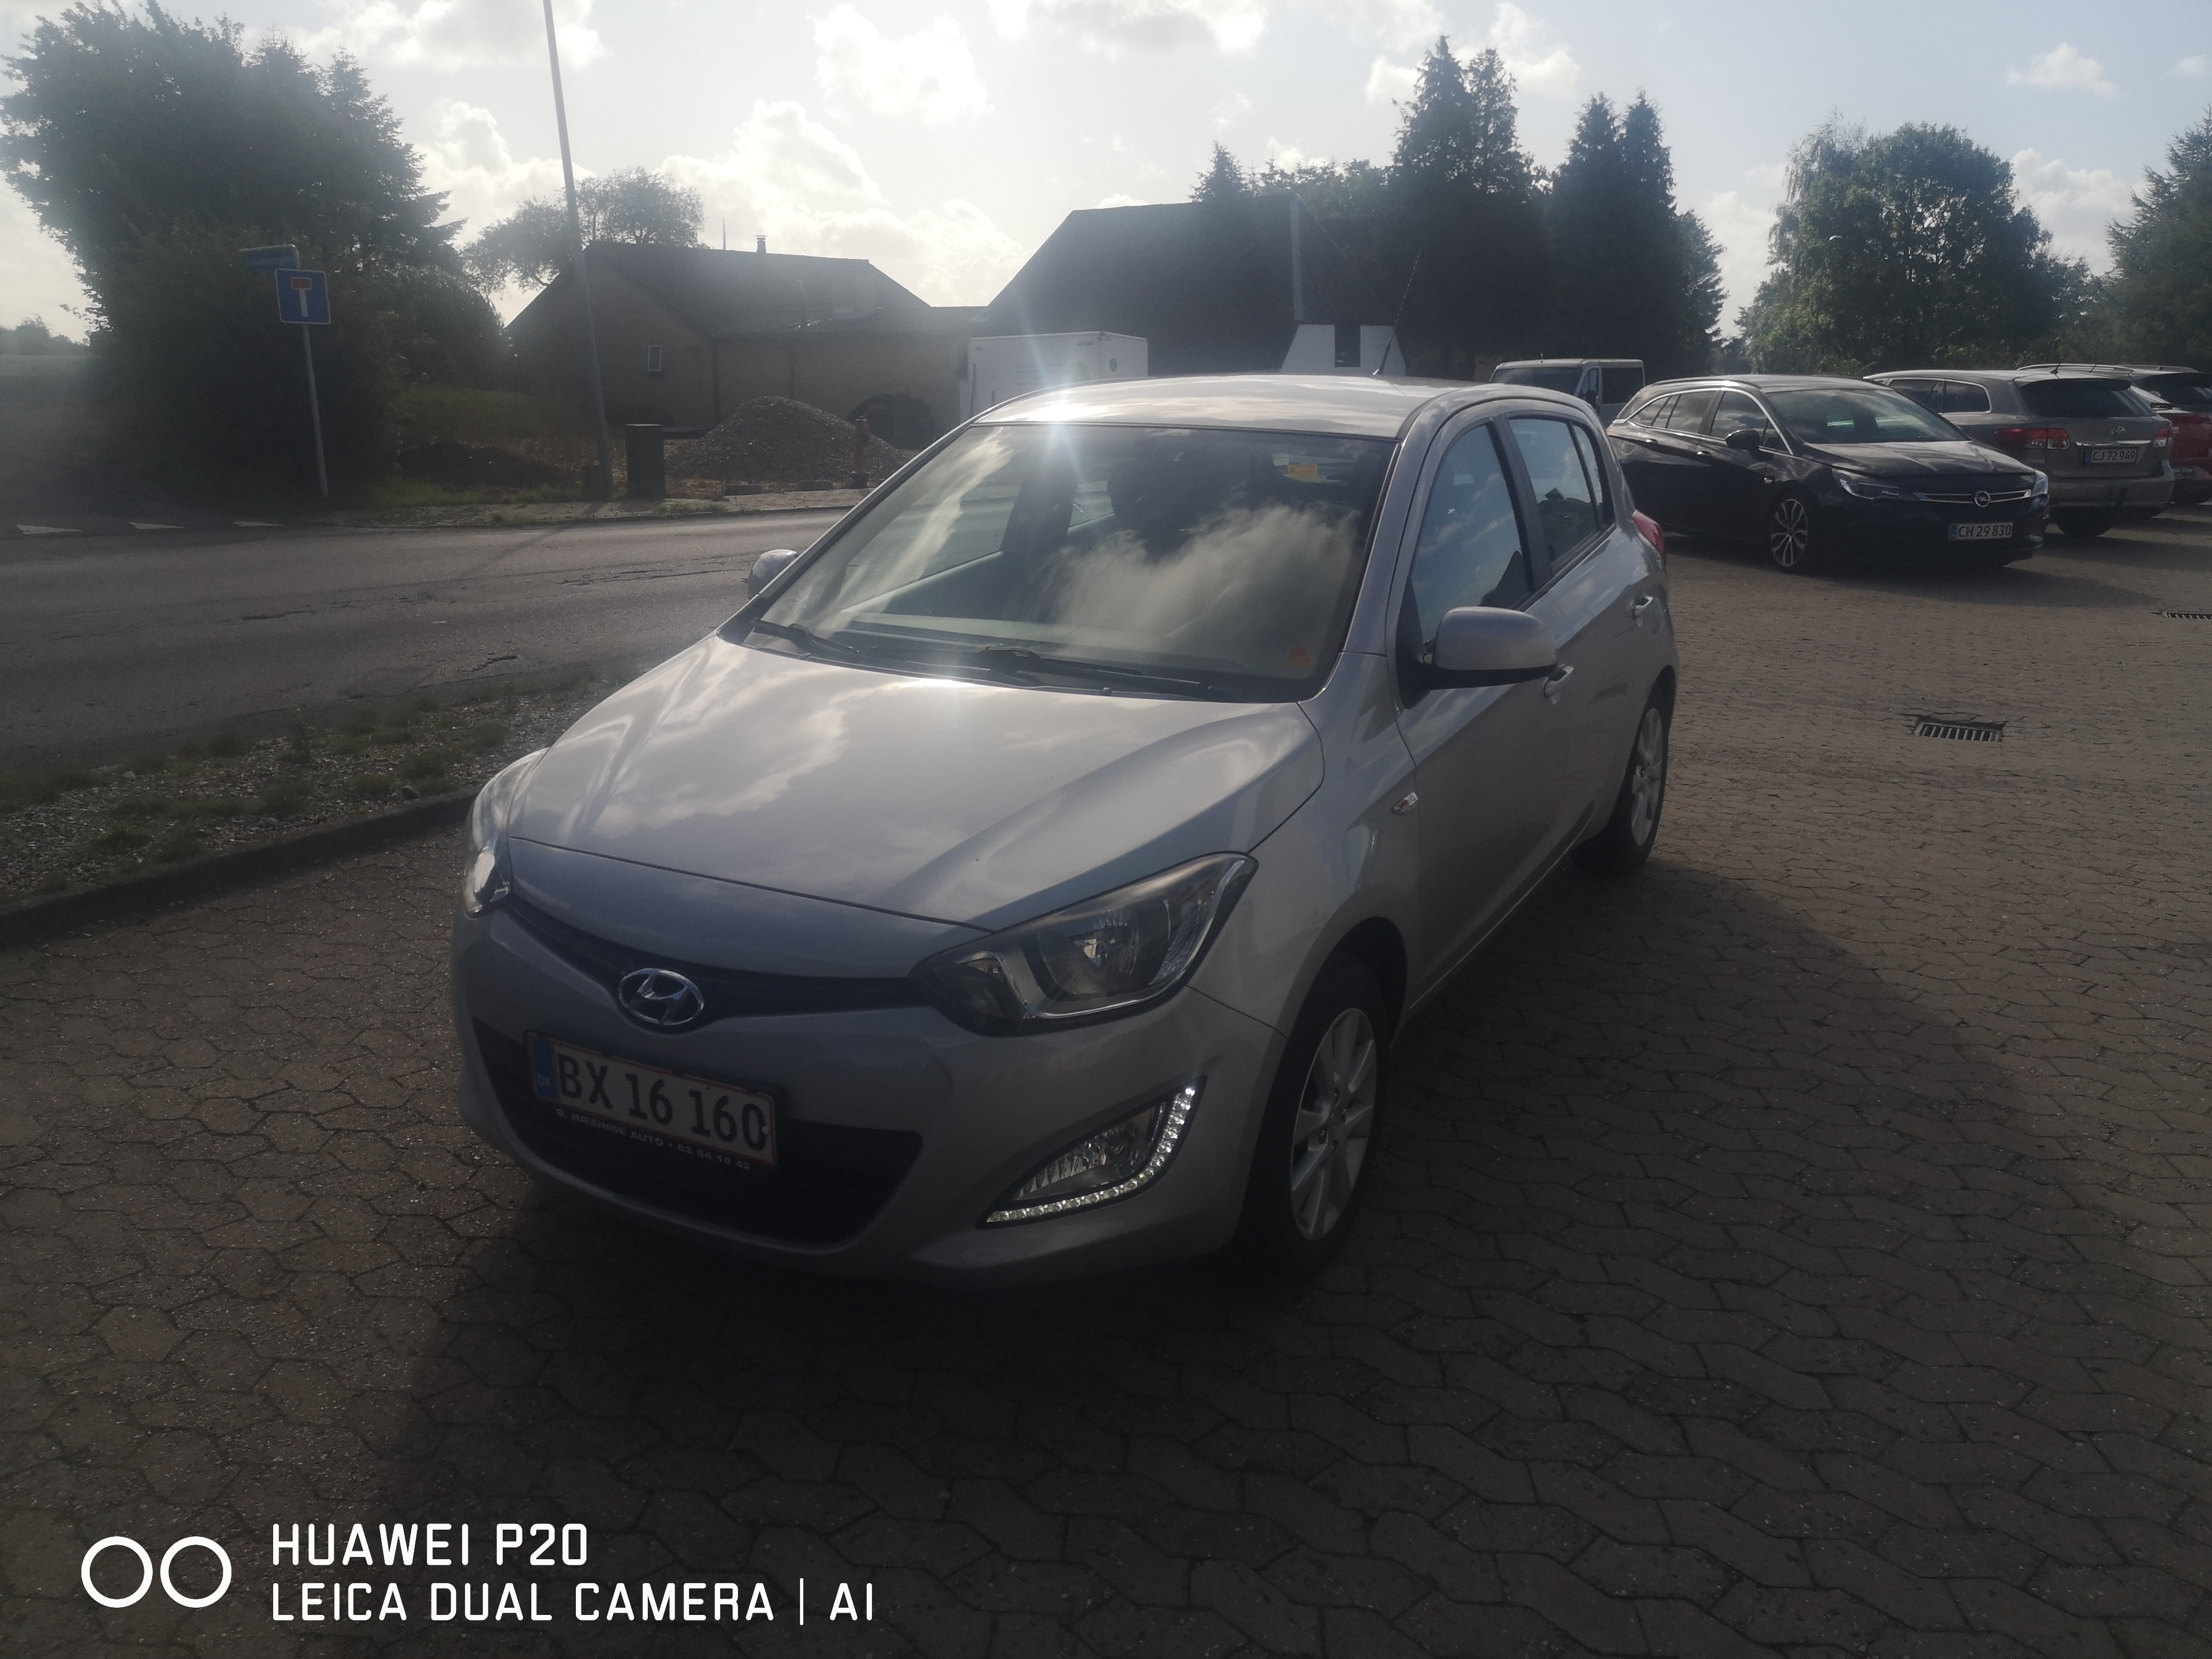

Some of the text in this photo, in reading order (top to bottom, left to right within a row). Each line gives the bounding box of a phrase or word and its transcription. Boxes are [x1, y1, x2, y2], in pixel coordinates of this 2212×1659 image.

[2093, 451, 2105, 461] CJ
[2107, 451, 2117, 461] 72
[1958, 524, 2011, 537] CH 29 830
[557, 1054, 767, 1151] BX 16 160
[630, 1131, 664, 1147] AUTO
[677, 1144, 693, 1155] 62
[716, 1155, 731, 1165] 10
[736, 1161, 751, 1171] 42
